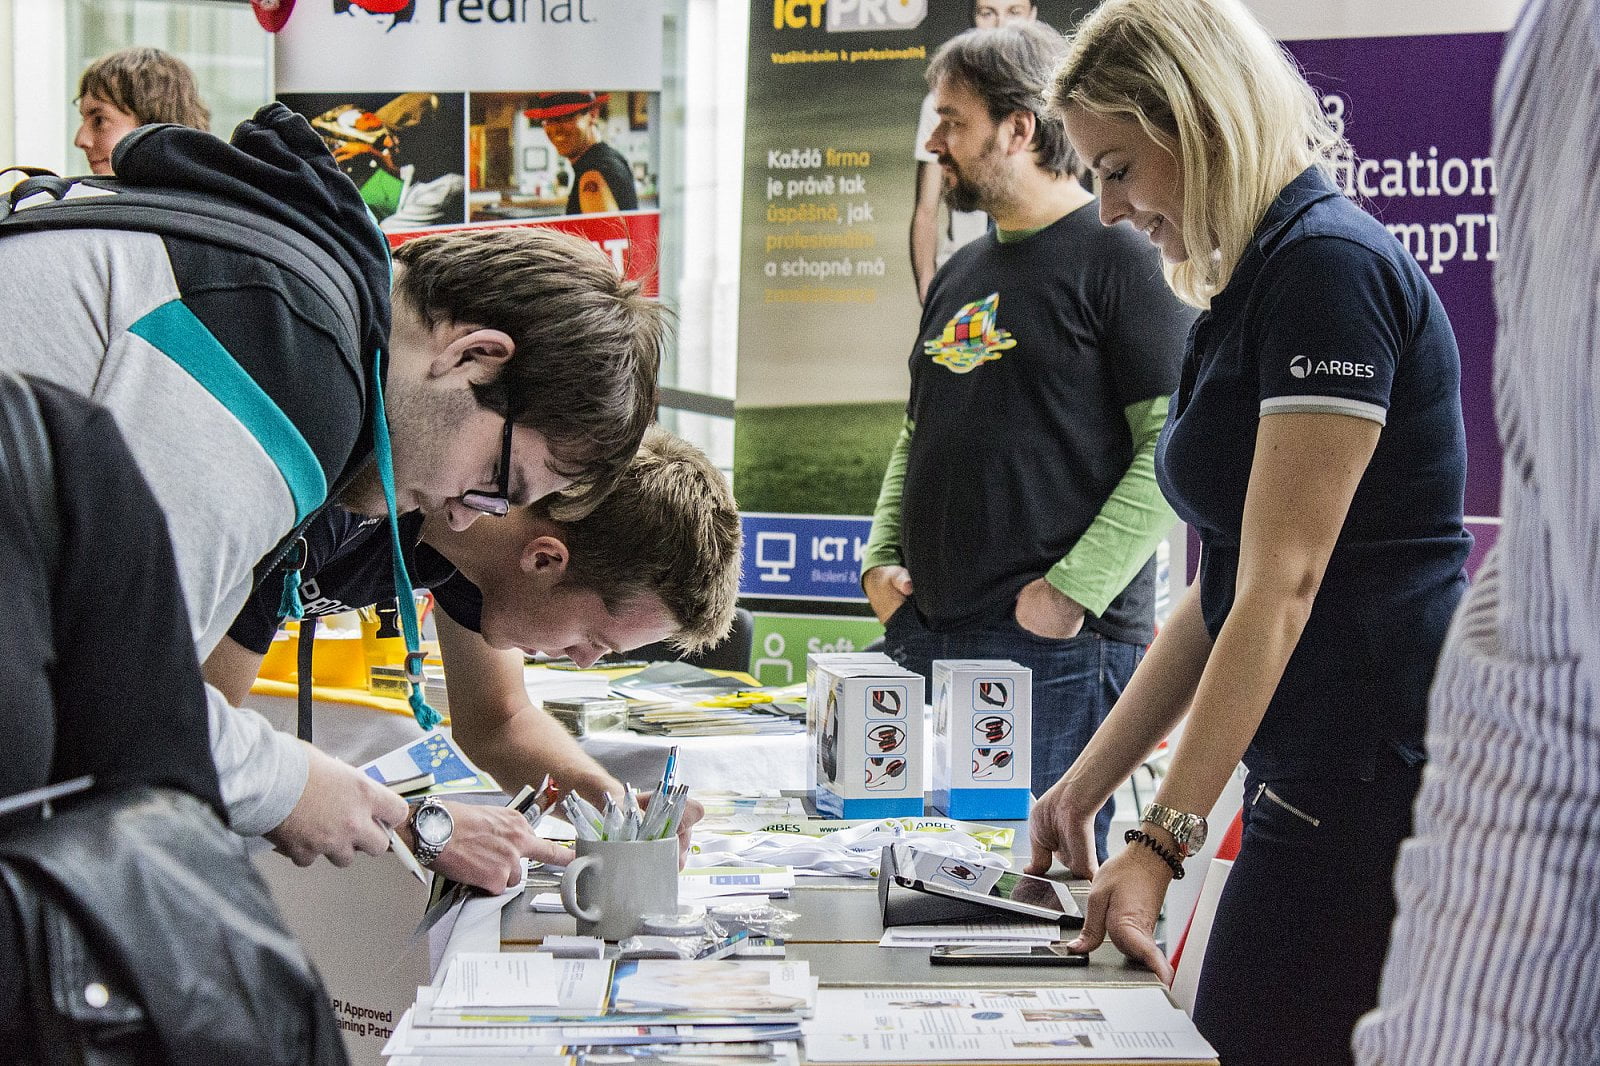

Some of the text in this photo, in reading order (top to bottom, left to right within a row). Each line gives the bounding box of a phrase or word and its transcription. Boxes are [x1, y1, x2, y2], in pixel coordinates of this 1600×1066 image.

[768, 147, 872, 169] Každá firma
[767, 176, 784, 200] je
[839, 174, 866, 194] tak
[847, 202, 874, 226] jak
[764, 260, 777, 278] a
[1314, 360, 1375, 379] ARBES
[811, 536, 849, 562] ICT
[344, 1002, 393, 1023] Approved
